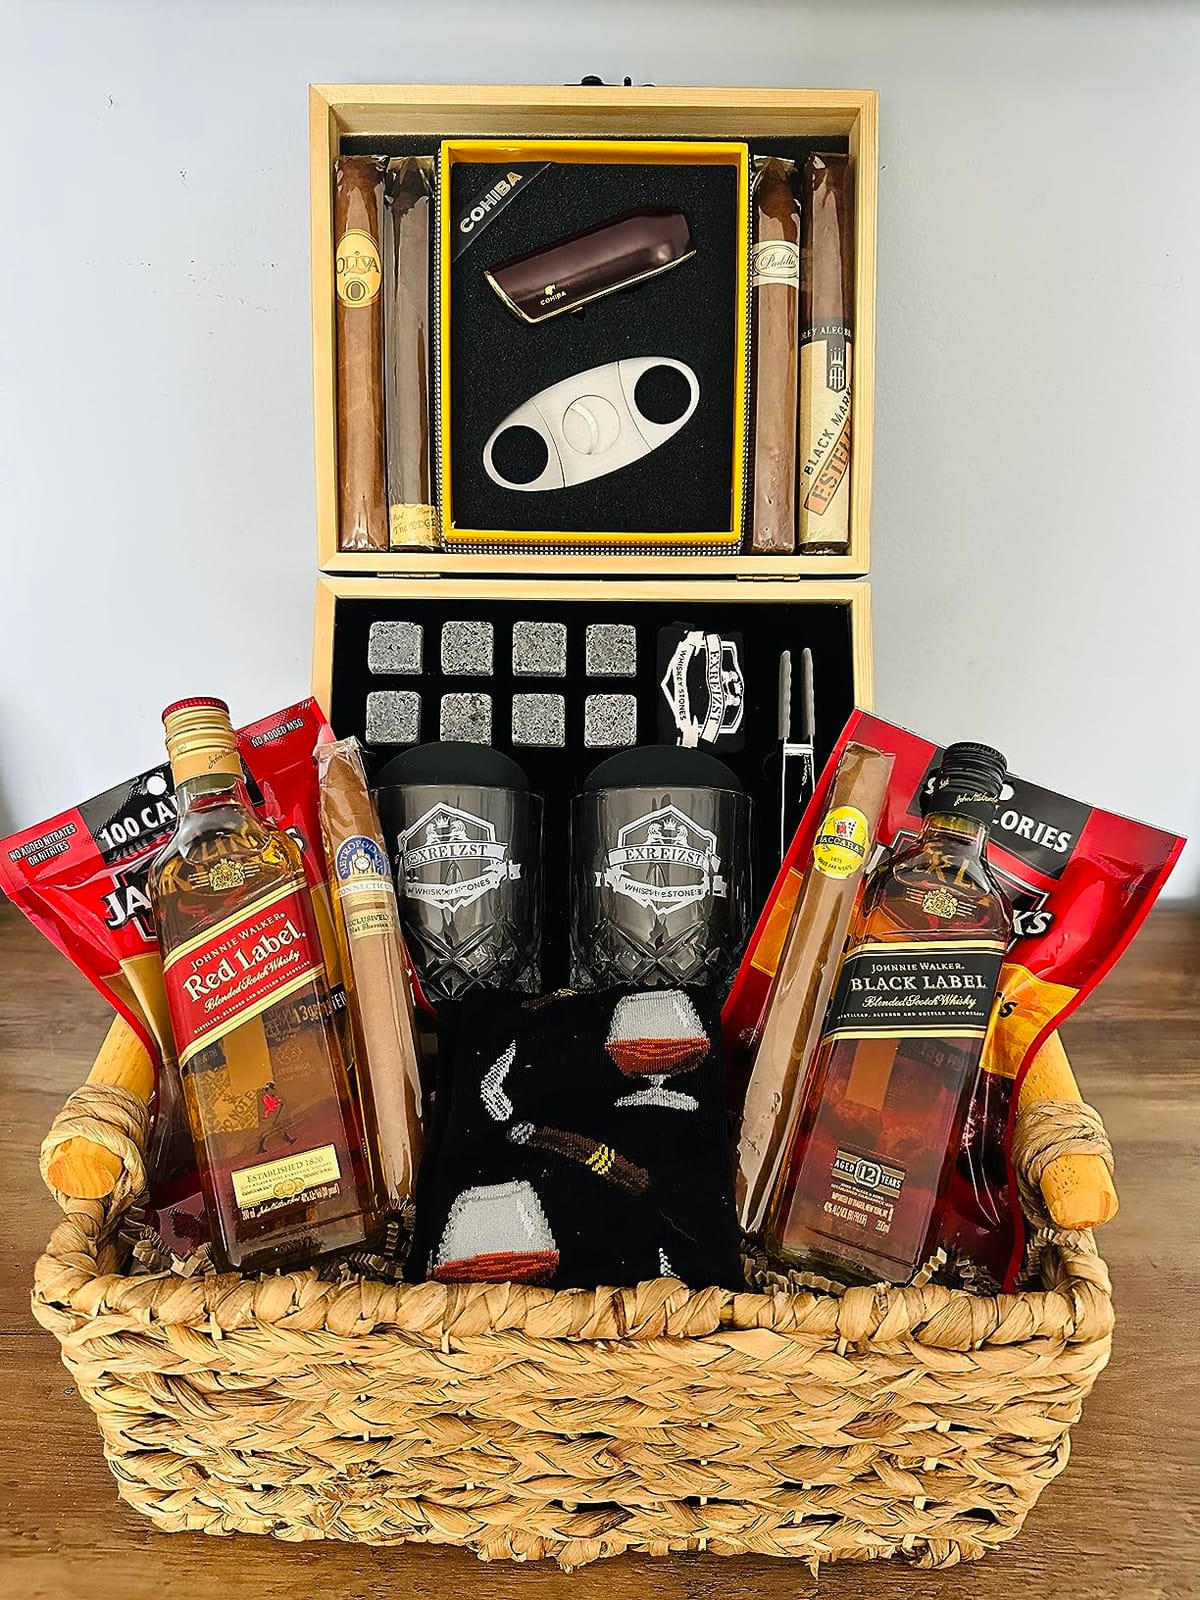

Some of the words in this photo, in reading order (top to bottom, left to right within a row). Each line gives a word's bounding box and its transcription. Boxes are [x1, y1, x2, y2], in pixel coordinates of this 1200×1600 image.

[459, 171, 524, 233] COHIBA
[336, 256, 381, 277] OLIVA
[540, 291, 567, 306] COHIBA
[804, 429, 835, 475] BLACK
[675, 650, 687, 687] WHISKEY
[709, 650, 723, 725] EXREIZST
[678, 688, 687, 721] STONES
[251, 737, 264, 748] NO
[263, 726, 287, 743] ADDED
[287, 717, 304, 734] MSG
[9, 850, 22, 861] NO
[21, 838, 43, 857] ADDED
[43, 824, 77, 846] NITRATES
[101, 817, 140, 848] 100
[28, 854, 39, 865] OR
[38, 842, 69, 861] NITRITES
[625, 847, 704, 866] EXREIZST
[190, 938, 239, 972] JOHNNIE
[871, 963, 918, 974] JOHNNIE
[182, 957, 238, 1003] Red
[203, 981, 243, 1014] Blended
[241, 968, 268, 990] Scotch
[265, 949, 301, 974] Whisky
[850, 976, 917, 992] BLACK
[923, 974, 988, 990] LABEL
[861, 995, 907, 1008] Blended
[905, 995, 939, 1008] Scotch
[936, 993, 977, 1009] Whisky
[246, 1161, 304, 1183] ESTABLISHED
[305, 1155, 324, 1167] 1820
[834, 1159, 854, 1173] AGED
[859, 1165, 877, 1183] 12
[881, 1174, 902, 1189] YEARS
